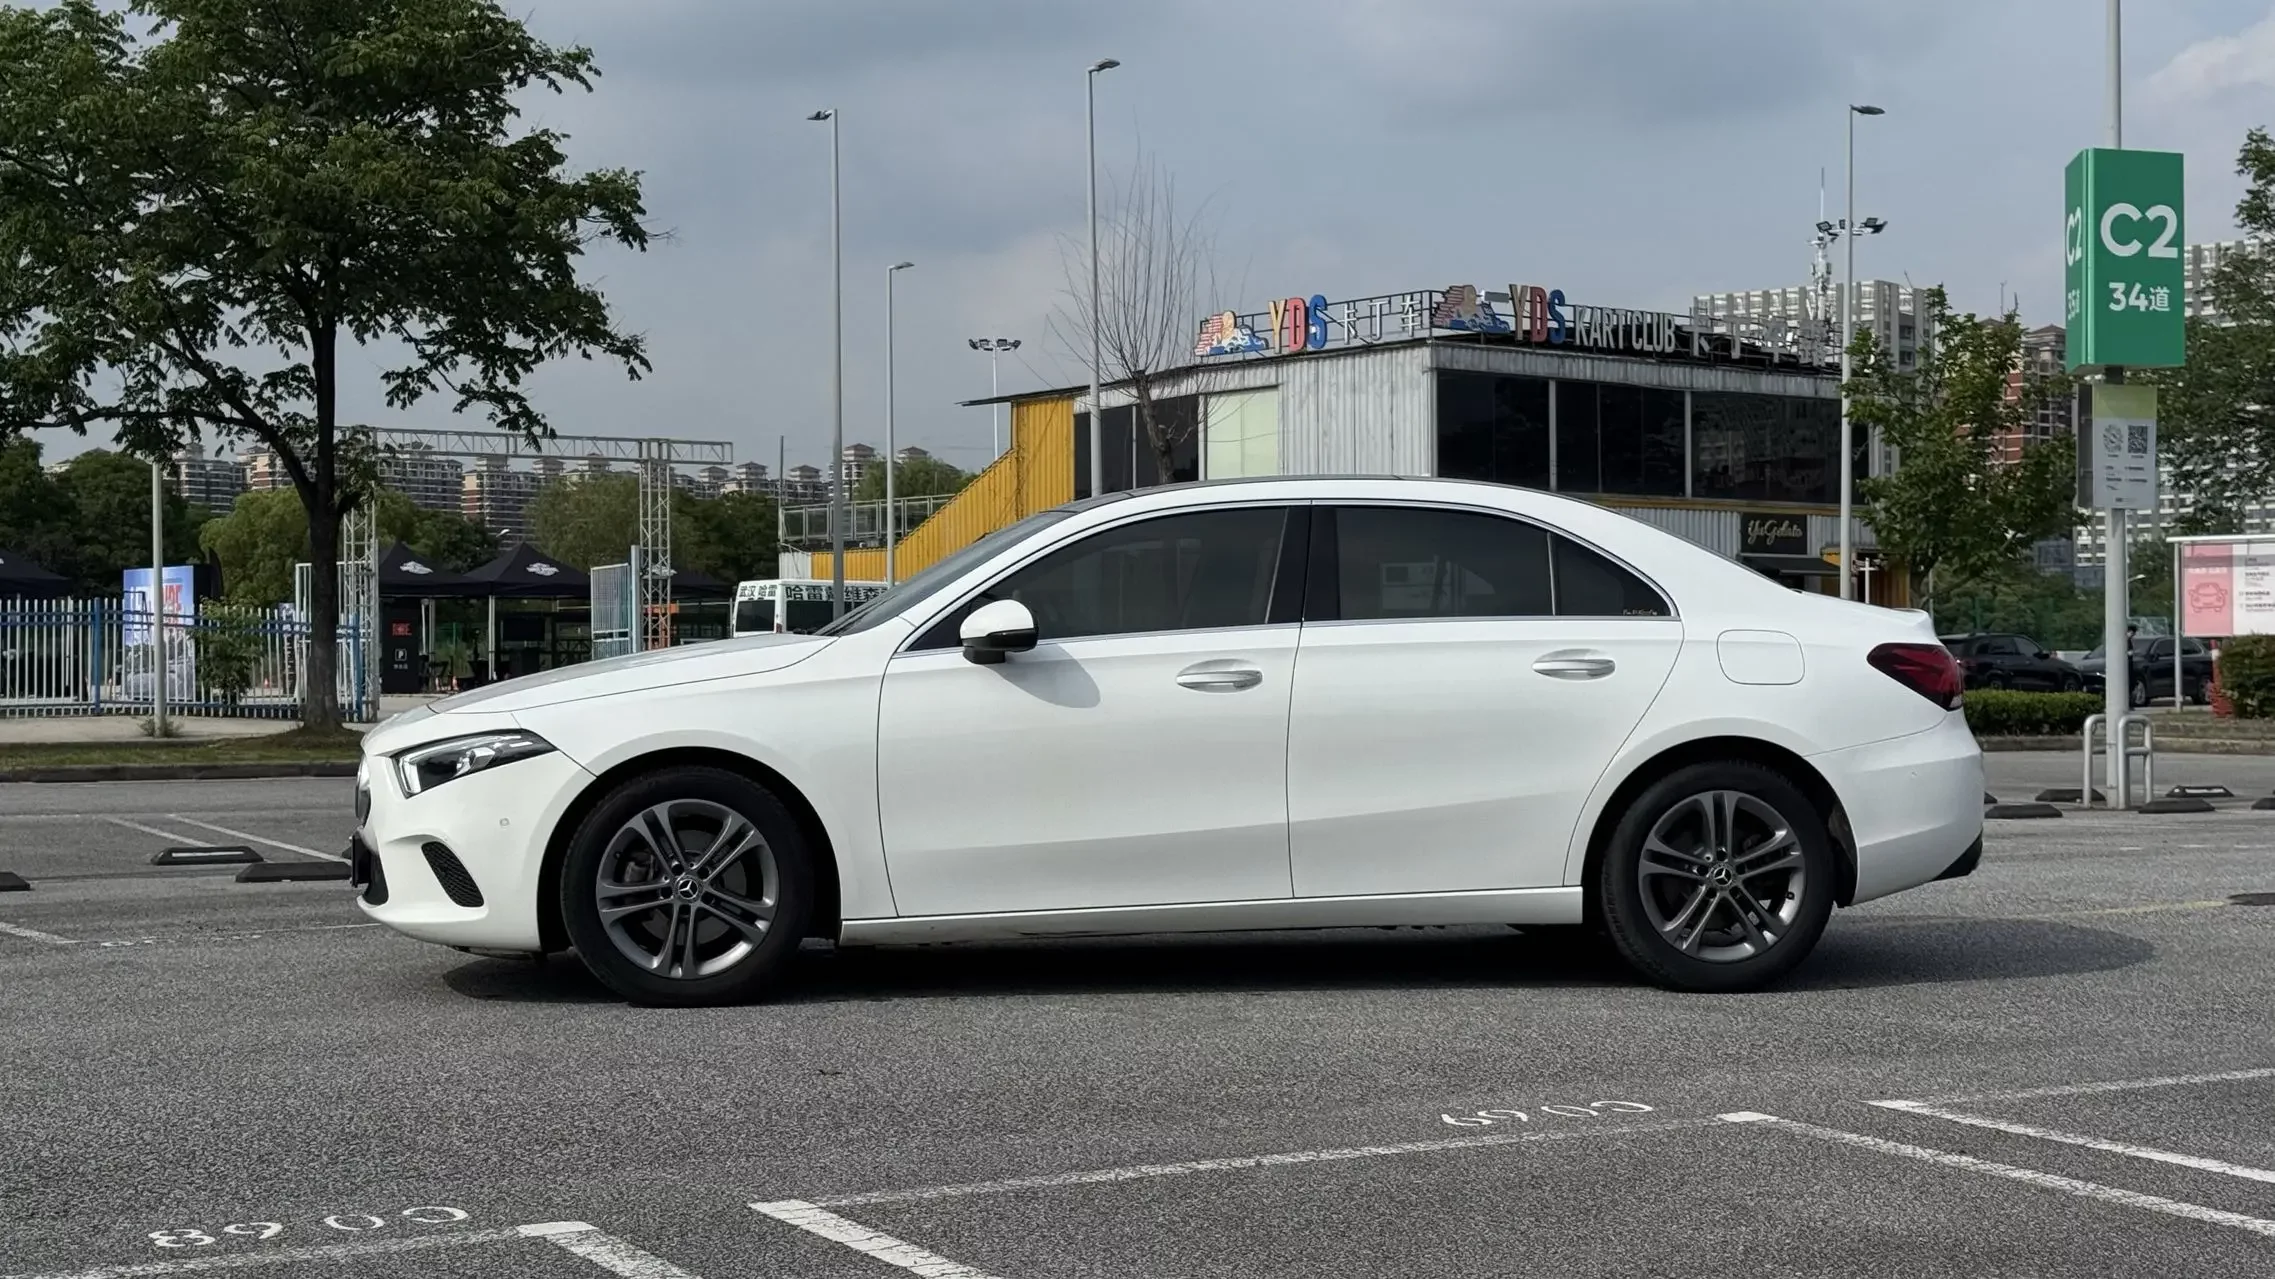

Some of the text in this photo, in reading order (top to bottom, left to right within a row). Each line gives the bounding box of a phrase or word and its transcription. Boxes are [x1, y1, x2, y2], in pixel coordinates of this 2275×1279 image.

[2066, 206, 2082, 267] C2
[2100, 202, 2179, 259] C2
[1269, 294, 1420, 354] YDS 卡丁车
[1508, 283, 1566, 344] YDS
[1574, 304, 1627, 350] KART
[1631, 308, 1677, 353] CLUB
[2108, 282, 2171, 312] 34道
[738, 585, 778, 598] 武汉 哈雷
